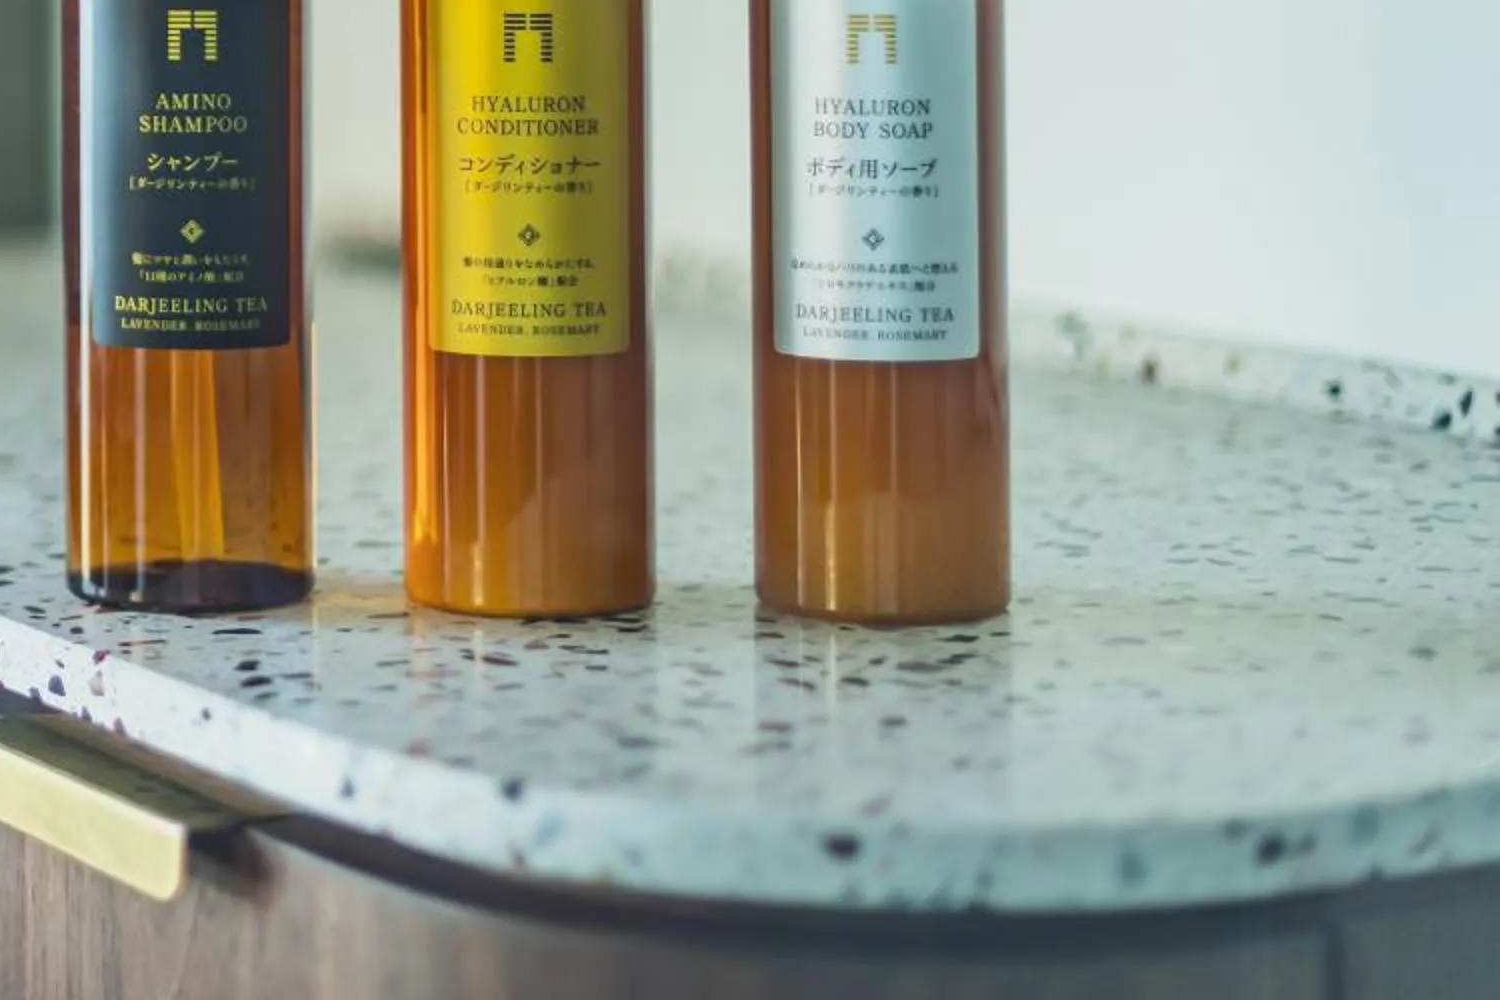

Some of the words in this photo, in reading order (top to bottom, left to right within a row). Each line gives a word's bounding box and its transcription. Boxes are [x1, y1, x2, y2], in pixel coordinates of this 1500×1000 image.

[155, 93, 231, 110] AMINO
[471, 95, 585, 113] HYALURON
[814, 96, 931, 116] HYALURON
[138, 115, 248, 133] SHAMPOO
[457, 118, 599, 136] CONDITIONER
[813, 121, 869, 139] BODY
[879, 122, 933, 139] SOAP
[147, 152, 238, 171] シャンプー
[459, 154, 601, 175] コンディショナー
[807, 156, 938, 179] ボディ用ソープ
[115, 296, 227, 314] DARJEELING
[236, 297, 268, 312] TEA
[452, 300, 565, 320] DARJEELING
[574, 302, 607, 318] TEA
[796, 305, 912, 323] DARJEELING
[919, 307, 954, 323] TEA
